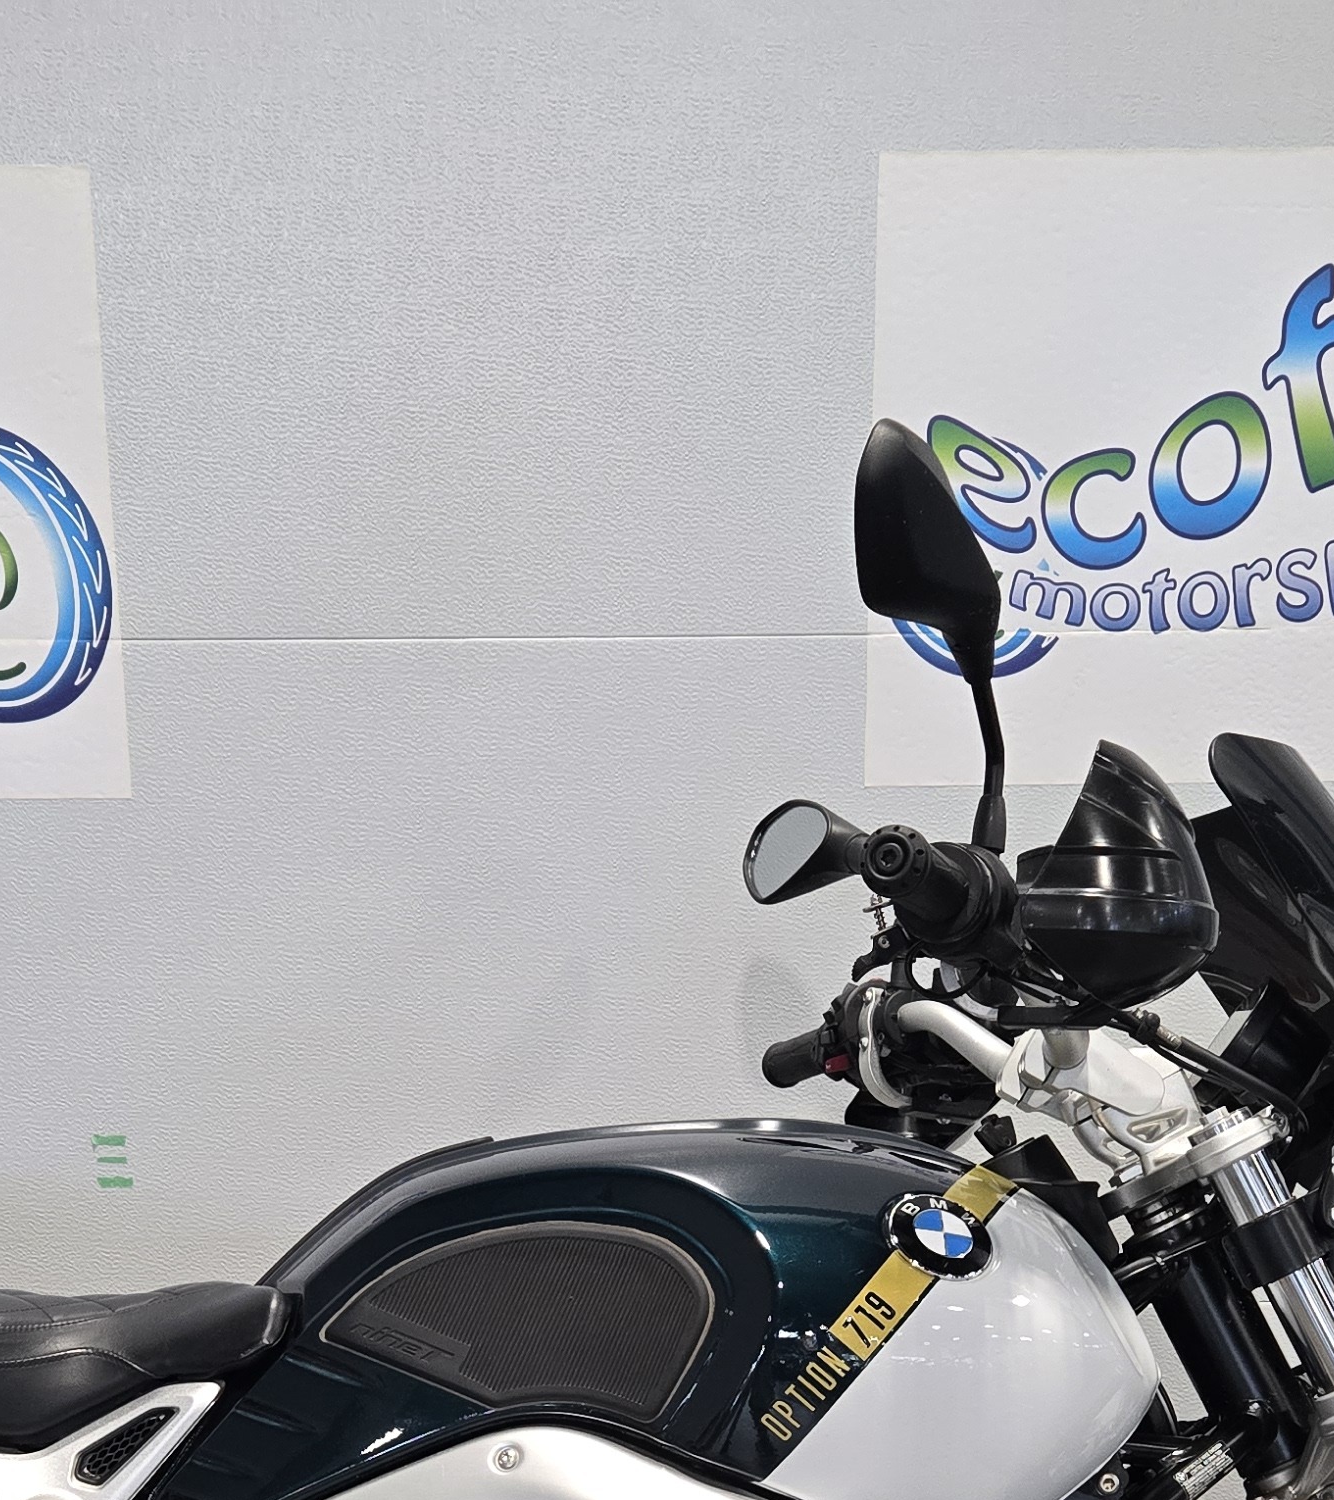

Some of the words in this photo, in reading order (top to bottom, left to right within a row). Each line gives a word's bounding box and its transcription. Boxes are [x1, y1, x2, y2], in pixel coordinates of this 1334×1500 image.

[900, 1198, 981, 1228] BMW
[760, 1345, 851, 1441] OPTION
[841, 1291, 897, 1349] 719
